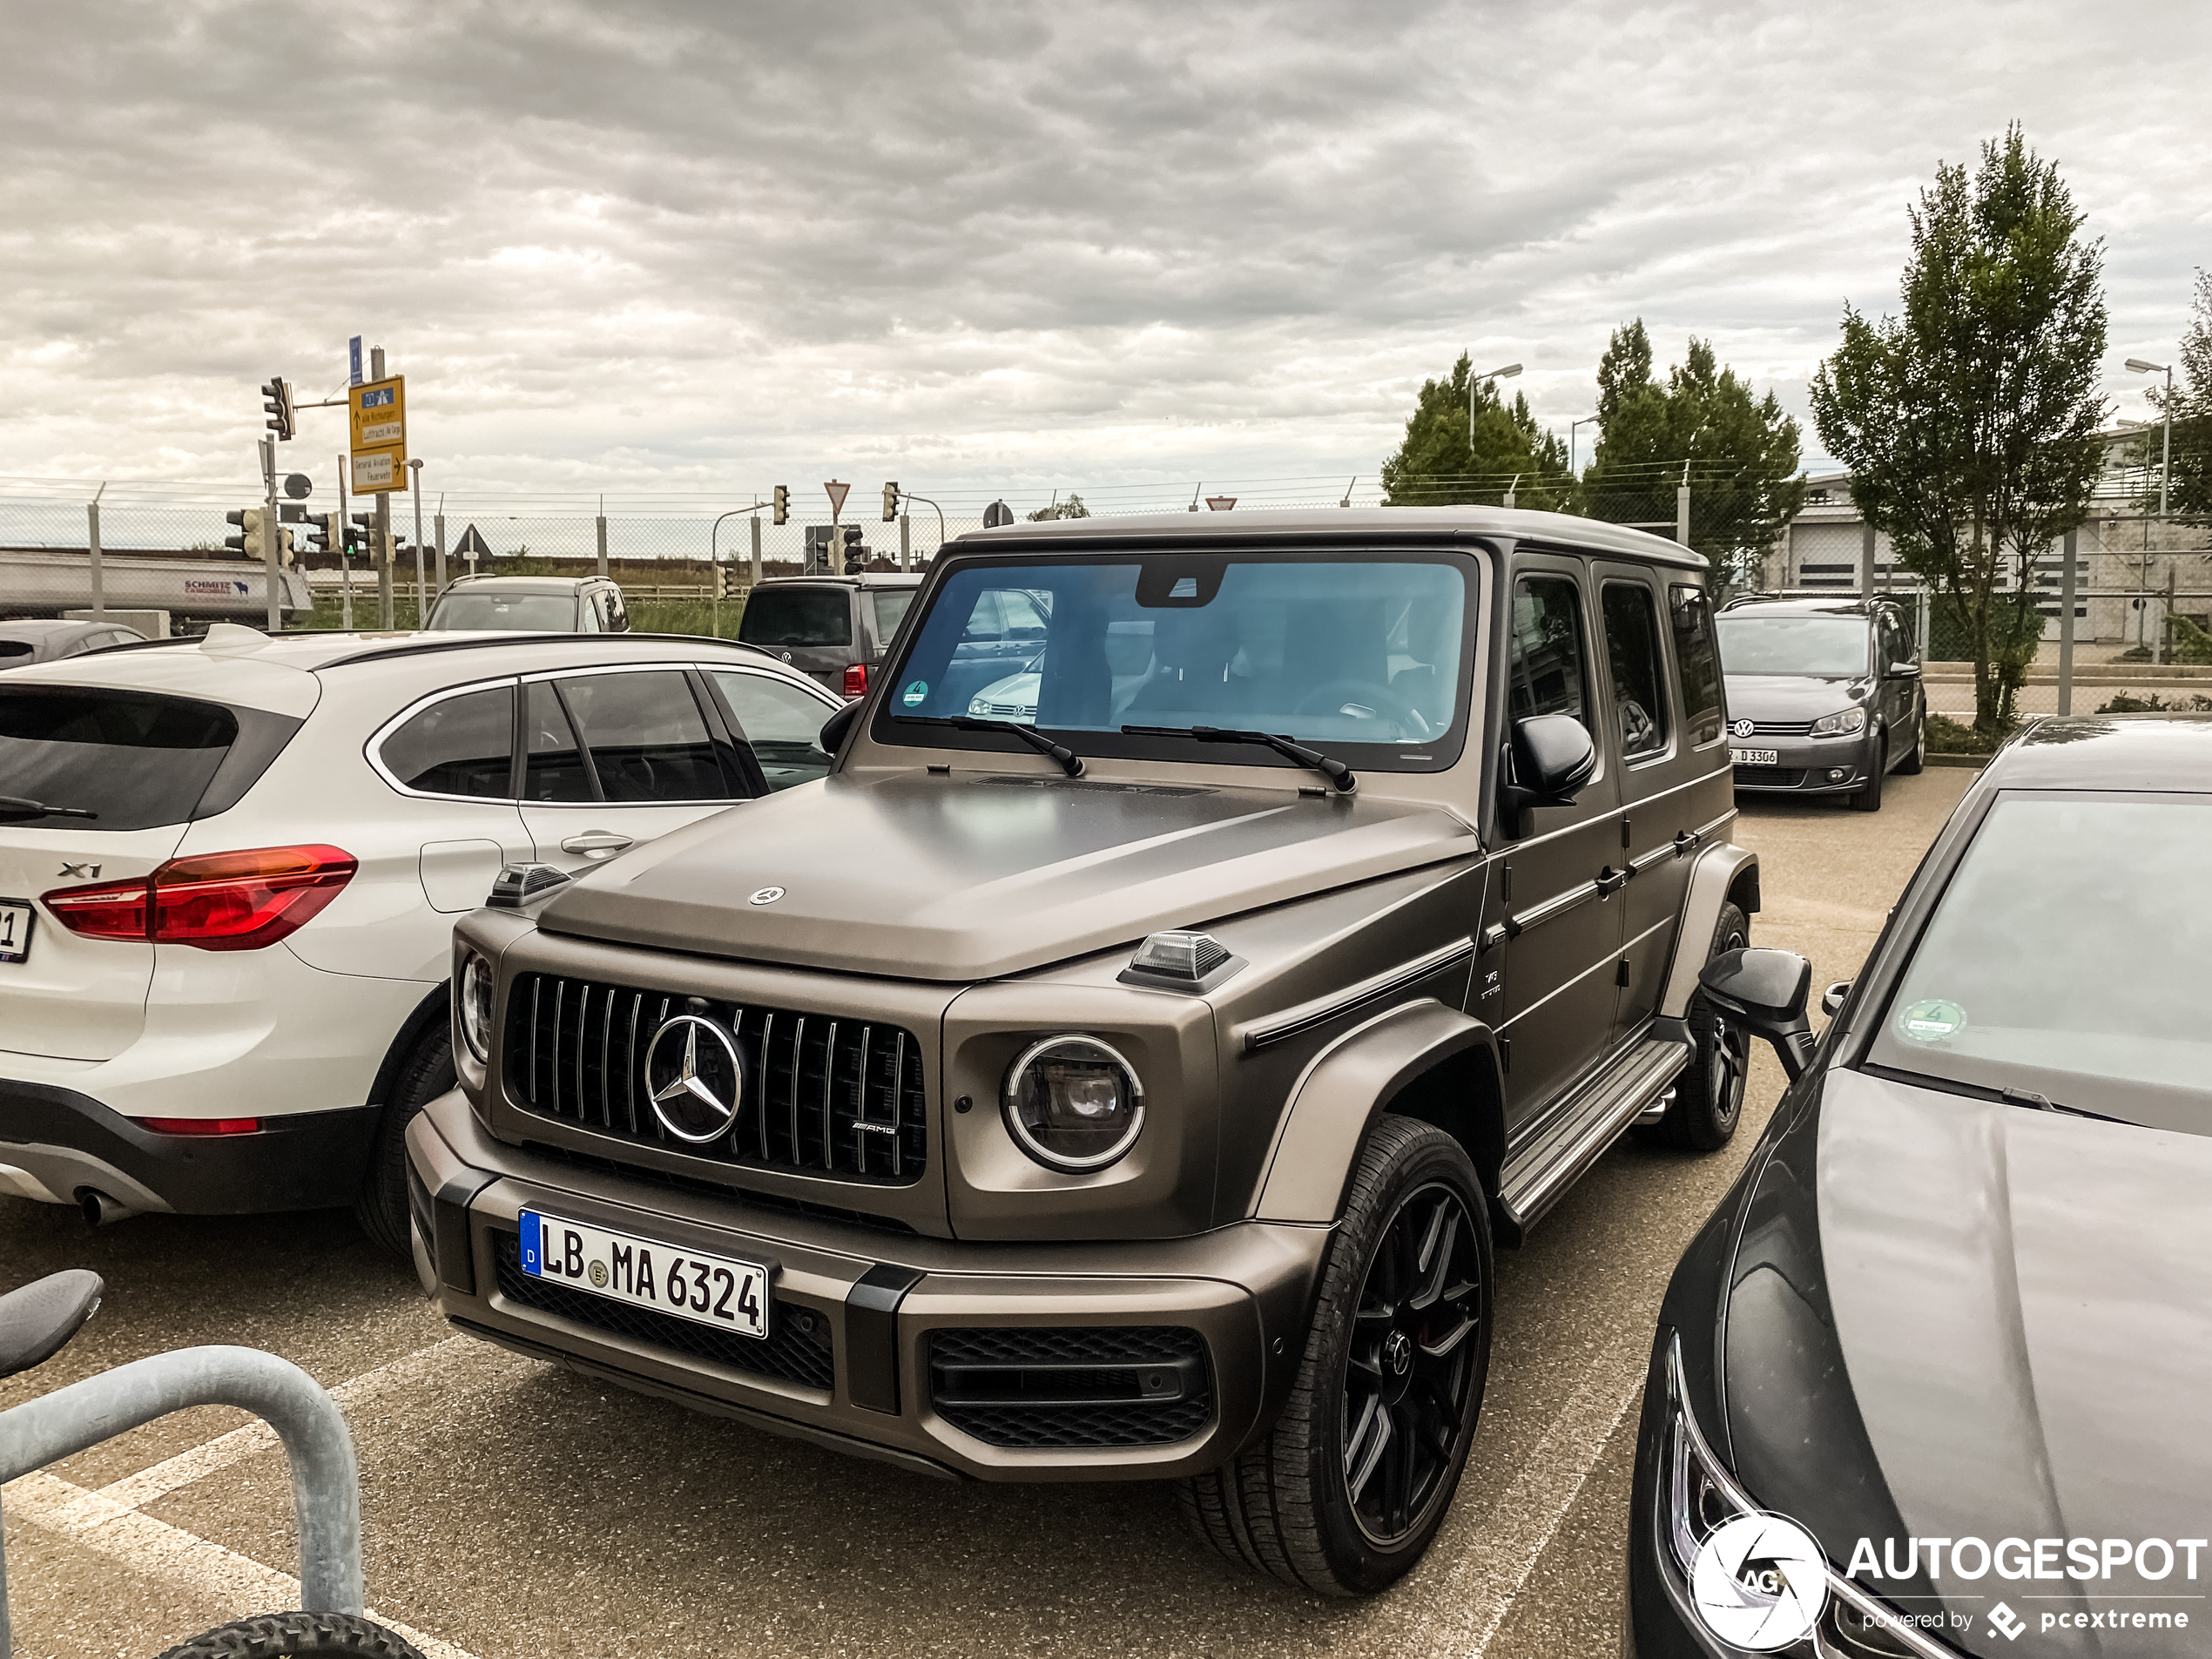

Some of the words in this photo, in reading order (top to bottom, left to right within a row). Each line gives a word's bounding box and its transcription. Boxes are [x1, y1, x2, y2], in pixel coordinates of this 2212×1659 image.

[913, 681, 922, 694] 4
[1741, 751, 1748, 761] D
[1750, 751, 1776, 763] 3306
[57, 861, 102, 879] X1
[0, 911, 15, 947] 1
[1925, 1005, 1943, 1021] 4
[865, 1123, 896, 1136] AMG
[527, 1249, 536, 1263] D
[543, 1224, 584, 1278] LB
[611, 1241, 656, 1300] MA
[666, 1258, 759, 1327] 6324
